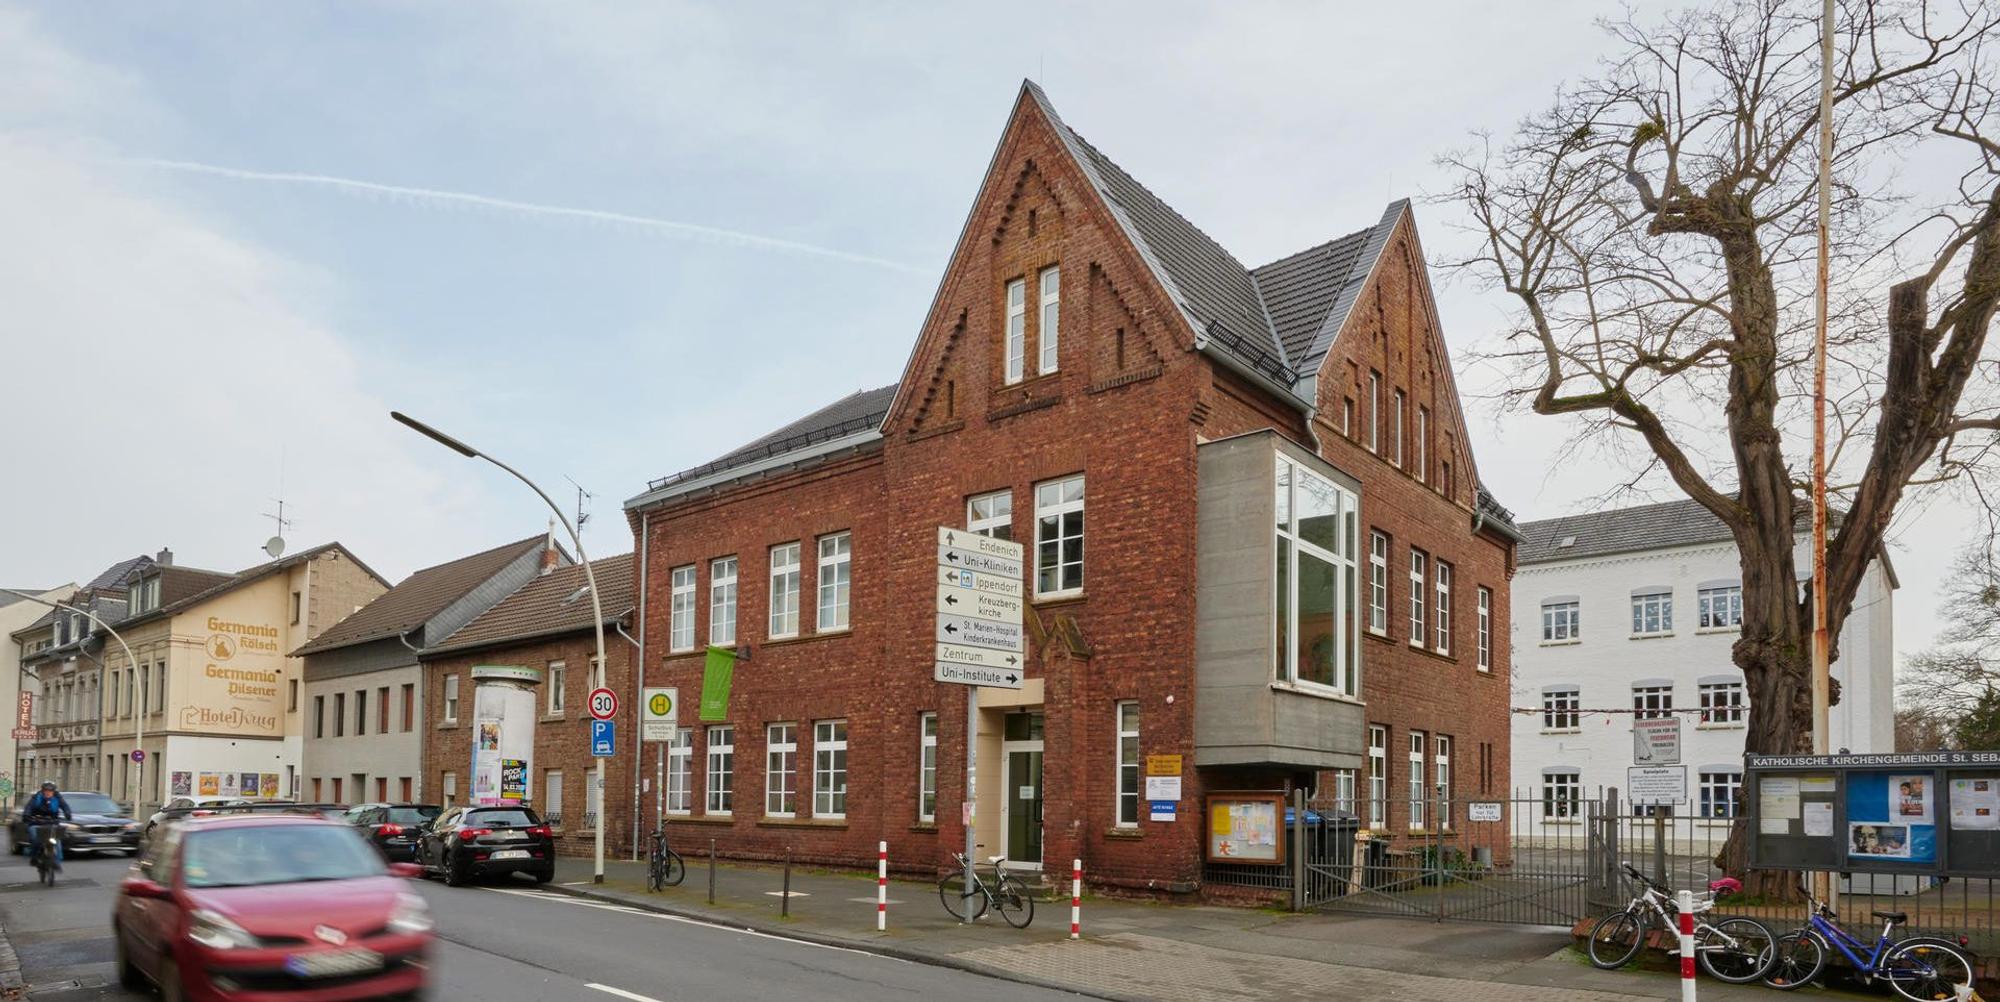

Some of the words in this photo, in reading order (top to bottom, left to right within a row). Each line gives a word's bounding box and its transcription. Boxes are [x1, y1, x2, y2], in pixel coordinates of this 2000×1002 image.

[980, 540, 1018, 557] Endenich
[964, 554, 1018, 575] Uni-Kliniken
[976, 576, 1018, 593] Ippendorf
[979, 594, 1020, 611] Kreuzberg-
[979, 606, 1001, 618] kirche
[207, 616, 278, 638] Germania
[963, 620, 972, 630] St.
[973, 622, 1018, 637] Marien-Hospital
[240, 636, 277, 651] Kölsch
[963, 633, 1017, 649] Kinderkrankenhaus
[943, 647, 983, 661] Zentrum
[205, 663, 276, 683] Germania
[942, 666, 1001, 683] Uni-Institute
[228, 682, 277, 697] Pilsener
[21, 692, 31, 728] HOTEL
[594, 696, 612, 711] 30
[655, 698, 666, 712] H
[200, 708, 237, 724] Hotel
[595, 723, 606, 737] P
[1753, 757, 1828, 766] KATHOLISCHE
[1832, 754, 1947, 765] KIRCHENGEMEINDE
[1952, 753, 1968, 762] St.
[1972, 753, 2000, 762] SEB
[503, 768, 521, 776] ROCK
